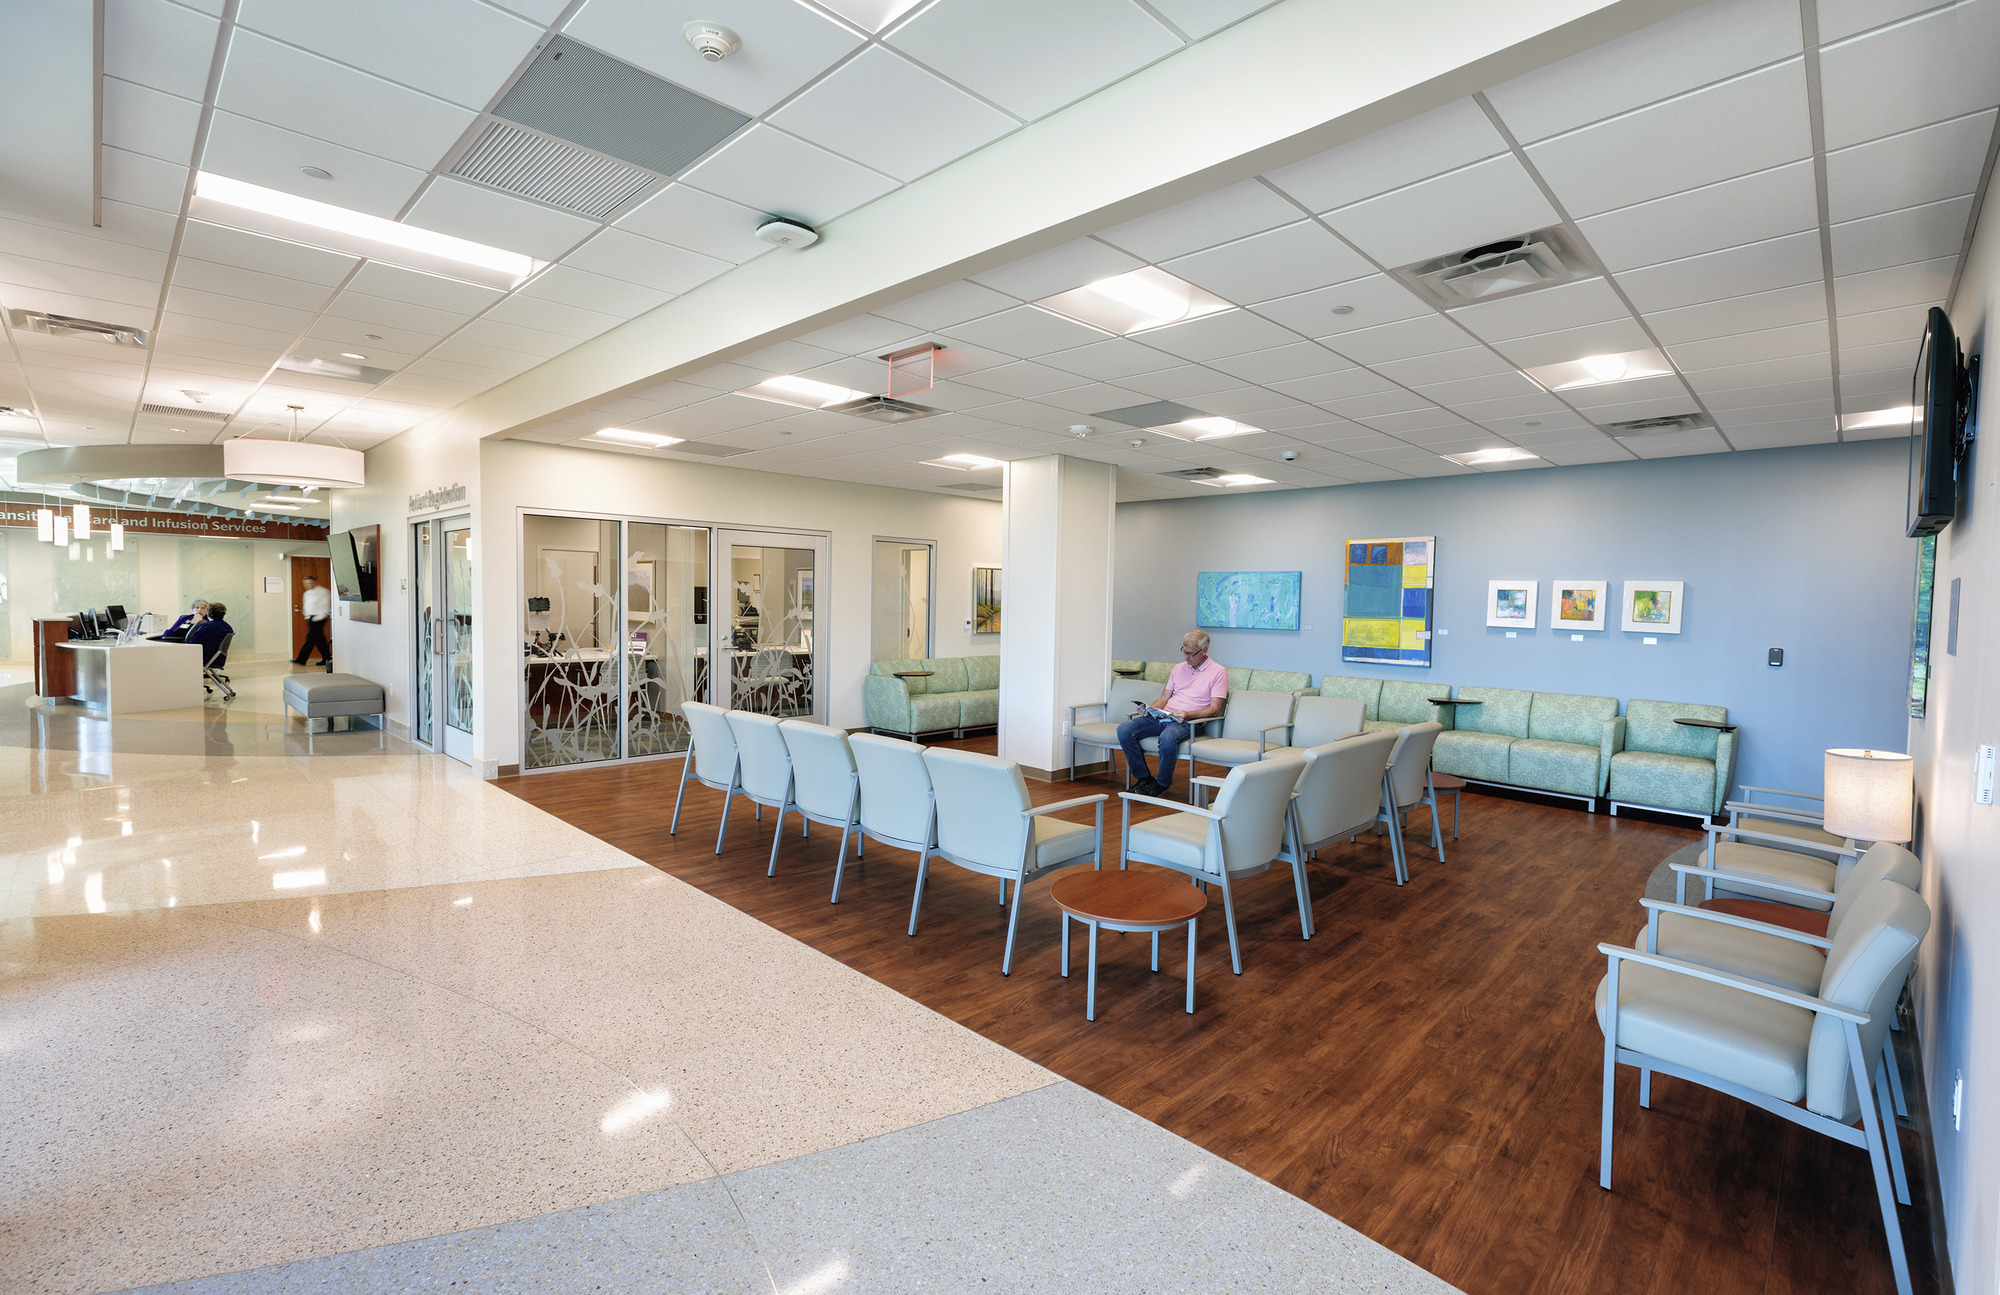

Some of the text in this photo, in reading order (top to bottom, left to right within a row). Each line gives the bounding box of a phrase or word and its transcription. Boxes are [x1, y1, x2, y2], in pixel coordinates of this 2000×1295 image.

[89, 514, 118, 525] are
[121, 517, 148, 527] and
[152, 517, 209, 530] Infusion
[212, 520, 267, 533] Services
